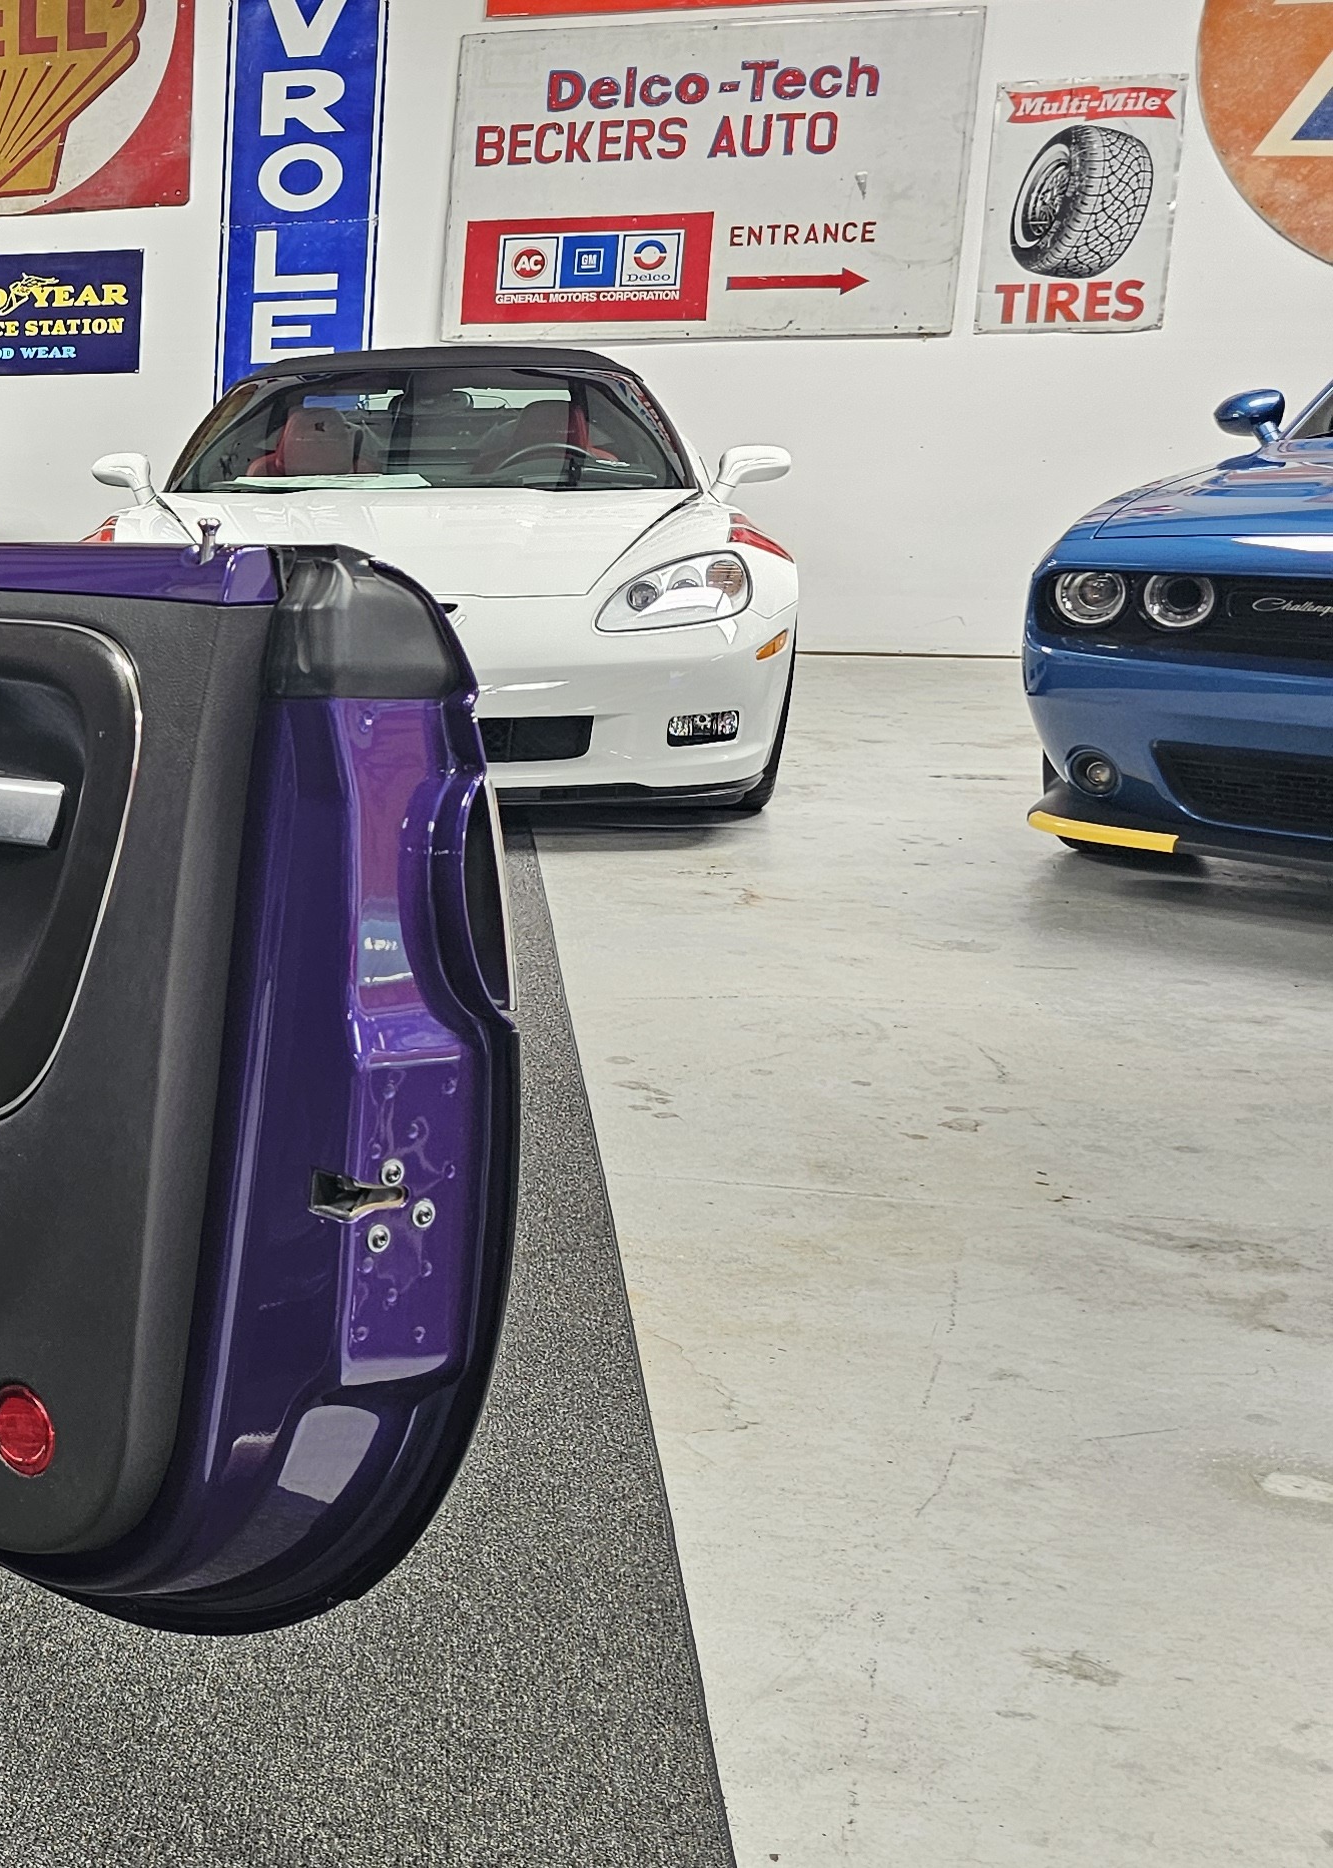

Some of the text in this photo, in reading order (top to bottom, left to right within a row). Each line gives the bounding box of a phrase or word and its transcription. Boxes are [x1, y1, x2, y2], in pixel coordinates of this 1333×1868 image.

[1016, 92, 1161, 117] Multi-Mile
[474, 110, 838, 168] BECKERS AUTO
[730, 221, 876, 247] ENTRANCE
[516, 255, 543, 272] AC
[581, 254, 597, 266] GM
[627, 272, 671, 282] Delco
[496, 290, 680, 305] GENERAL MOTORS CORPORATION
[995, 280, 1146, 324] TIRES
[24, 318, 124, 338] STATION
[20, 346, 76, 360] WEAR
